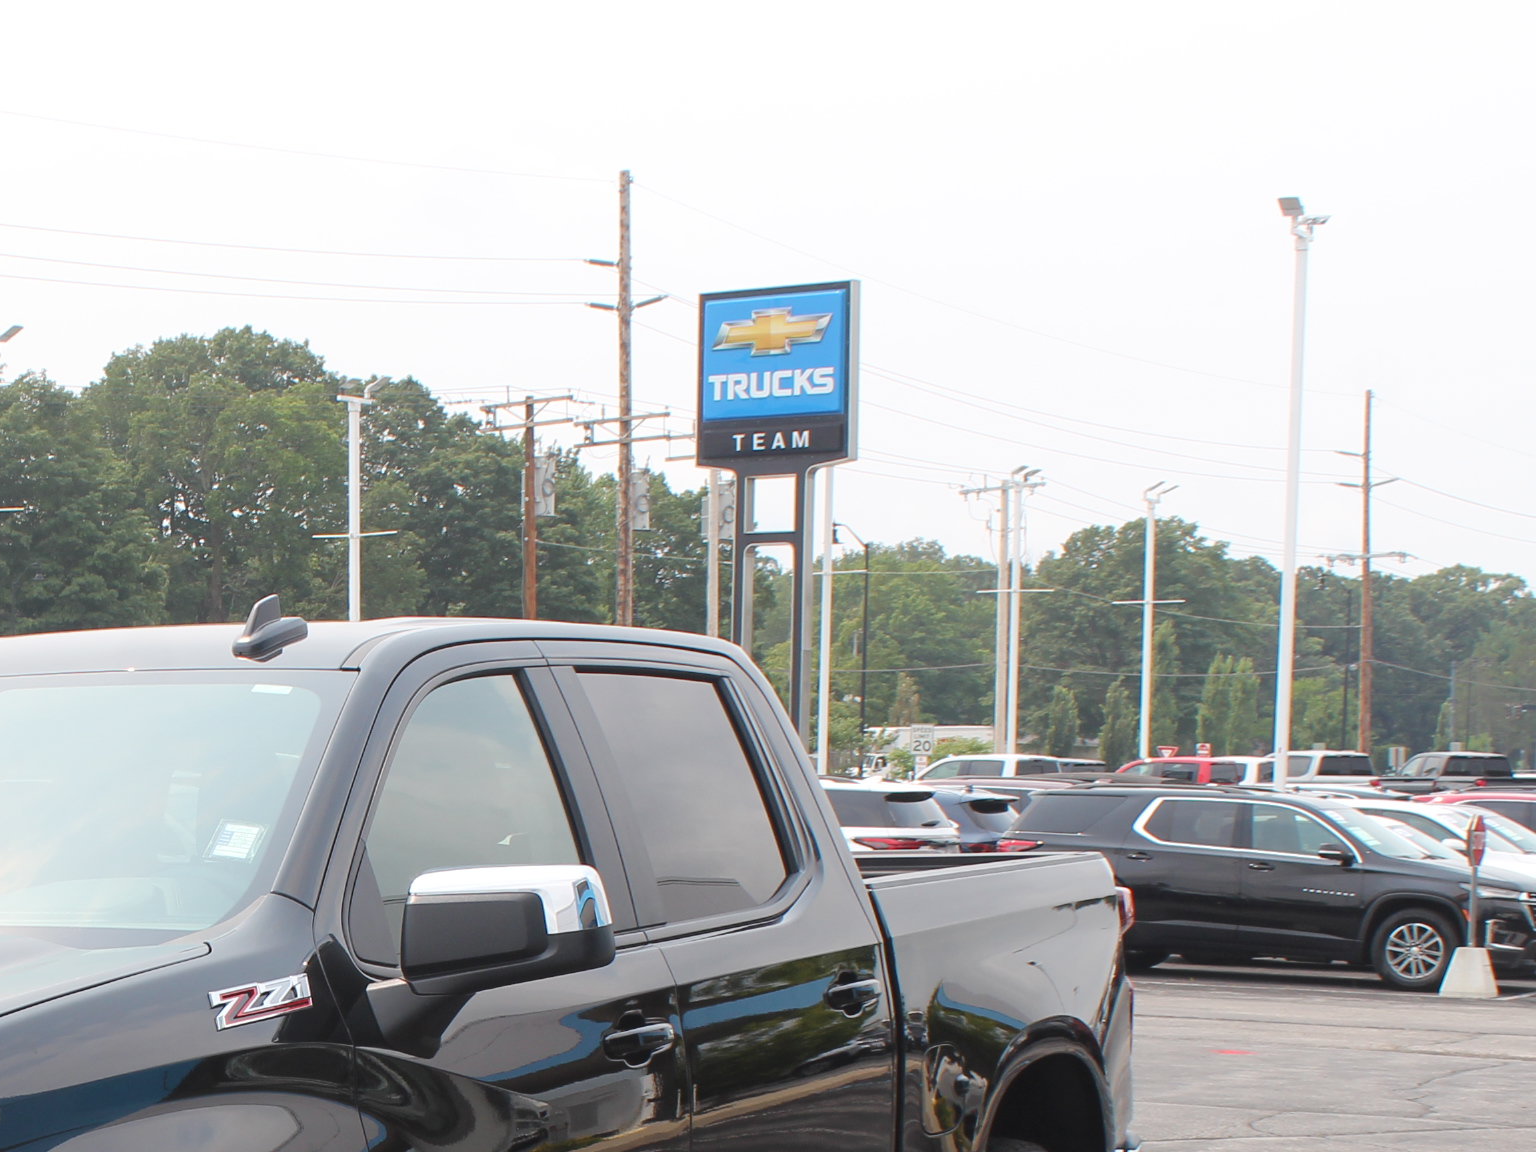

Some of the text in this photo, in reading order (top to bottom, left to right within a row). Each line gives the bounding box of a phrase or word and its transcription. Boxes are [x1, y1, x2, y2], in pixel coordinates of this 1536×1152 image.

[708, 366, 835, 401] TRUCKS
[732, 429, 810, 452] TEAM
[913, 740, 932, 752] 20
[208, 973, 313, 1031] Z71
